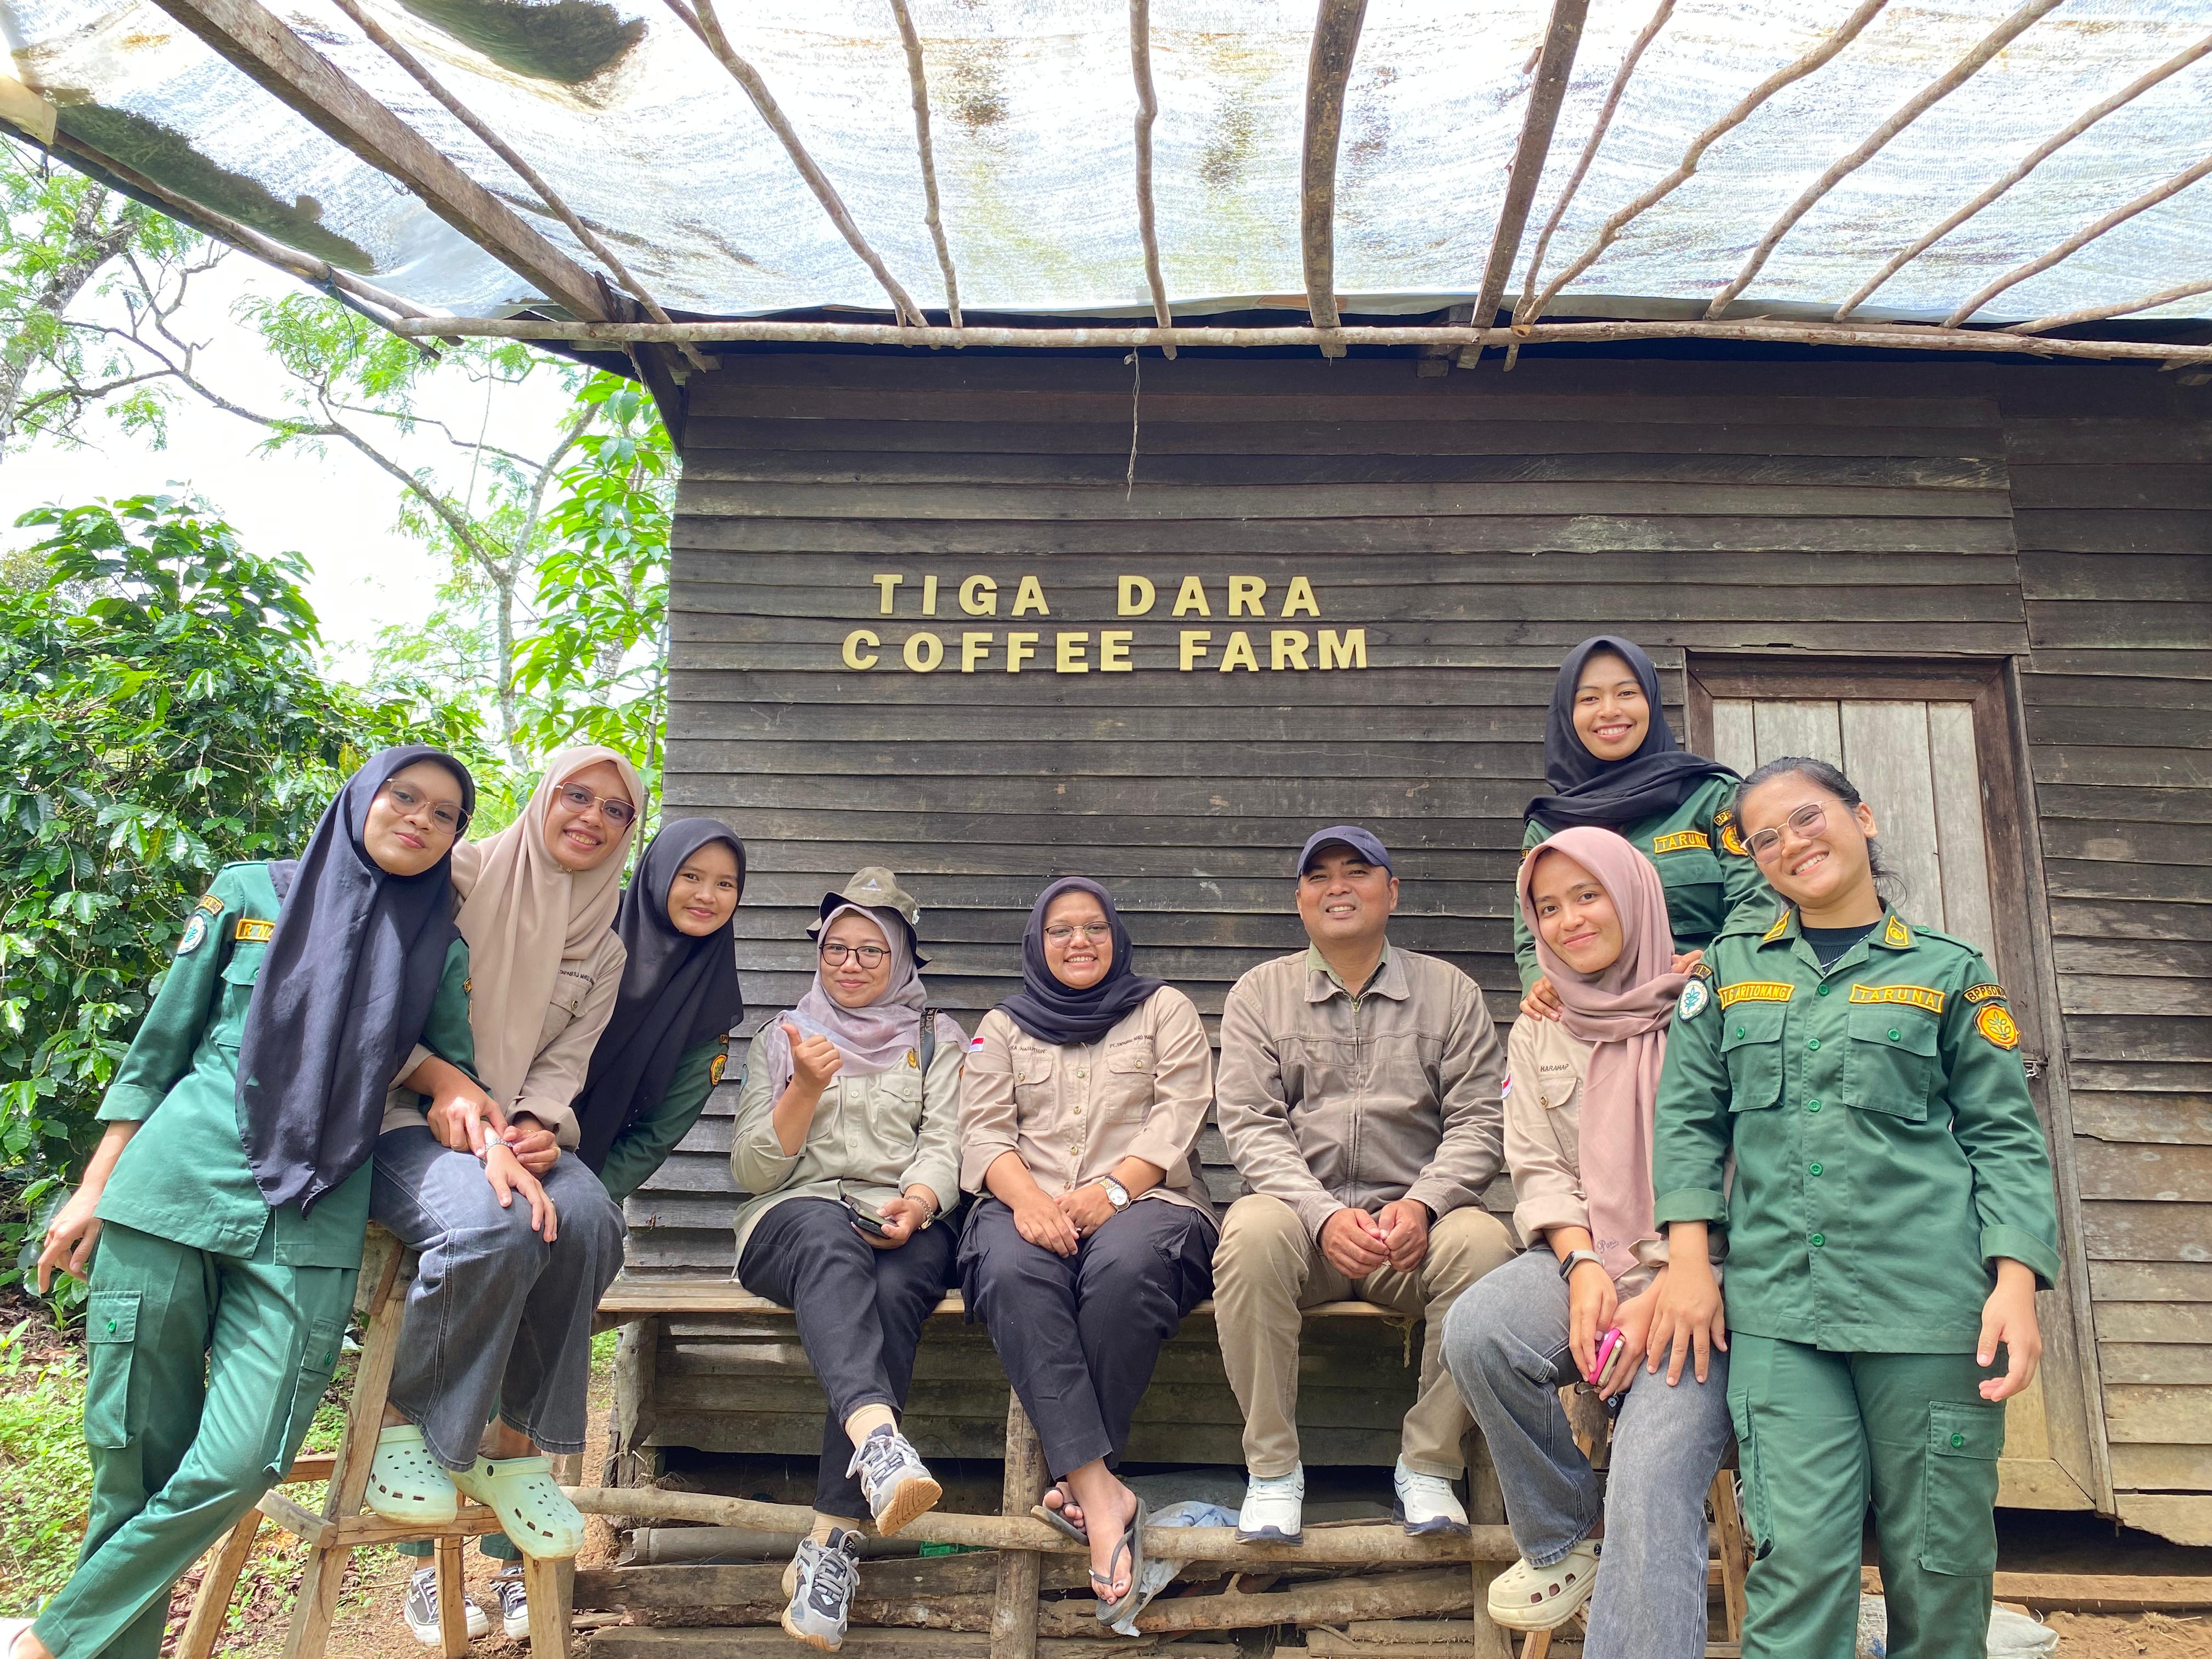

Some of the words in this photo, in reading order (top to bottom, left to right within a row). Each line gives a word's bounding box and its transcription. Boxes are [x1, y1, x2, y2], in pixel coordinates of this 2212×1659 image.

[873, 574, 1050, 617] TIGA
[1118, 575, 1321, 618] DARA
[842, 629, 1133, 673] COFFEE
[1180, 629, 1368, 672] FARM
[1859, 989, 1935, 1008] TARUNA
[1541, 1063, 1569, 1073] HARAHAP
